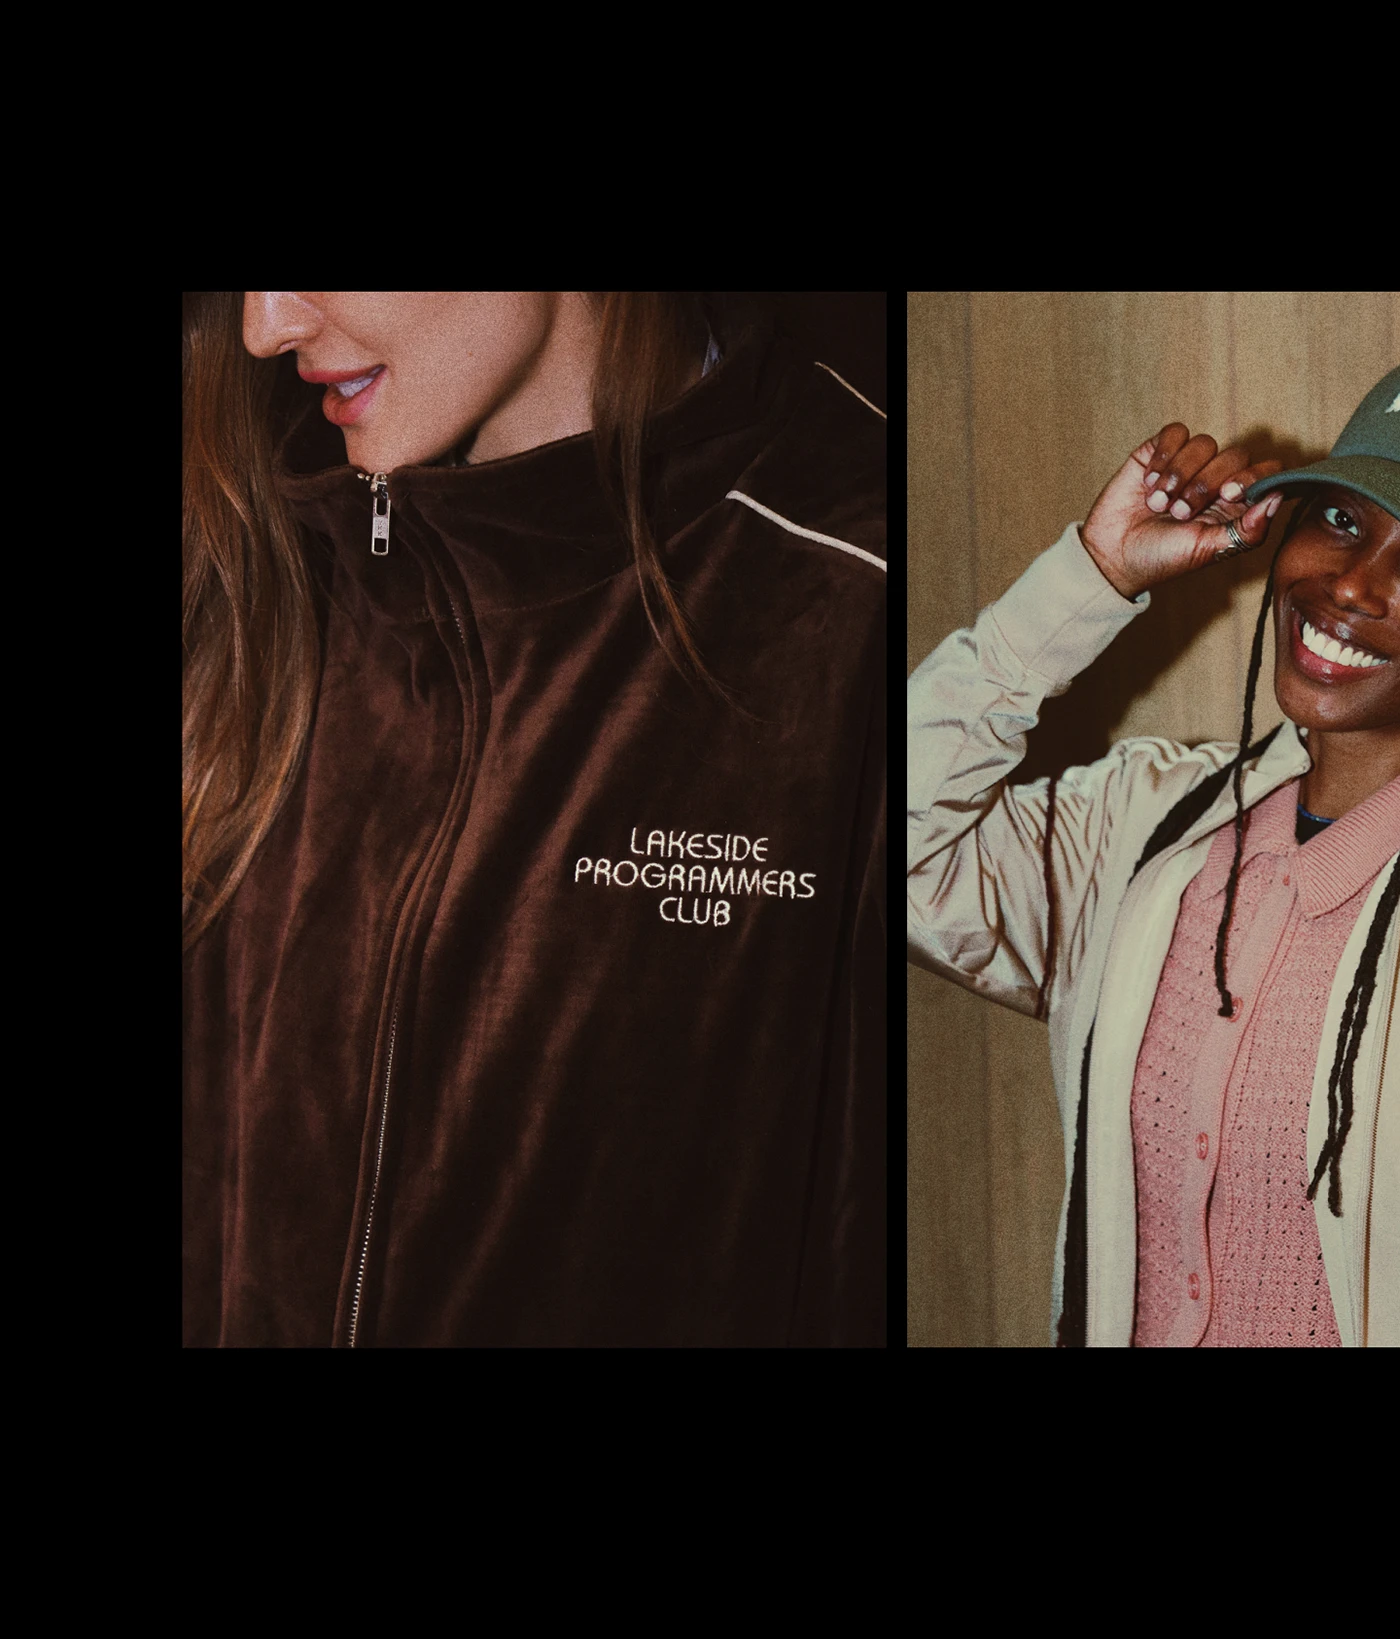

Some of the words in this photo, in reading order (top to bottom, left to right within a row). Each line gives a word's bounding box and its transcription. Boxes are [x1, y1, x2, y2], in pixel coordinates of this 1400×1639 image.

[630, 827, 769, 862] LAKESIDE
[574, 857, 817, 899] PROGRAMMERS
[659, 896, 732, 927] CLUB
